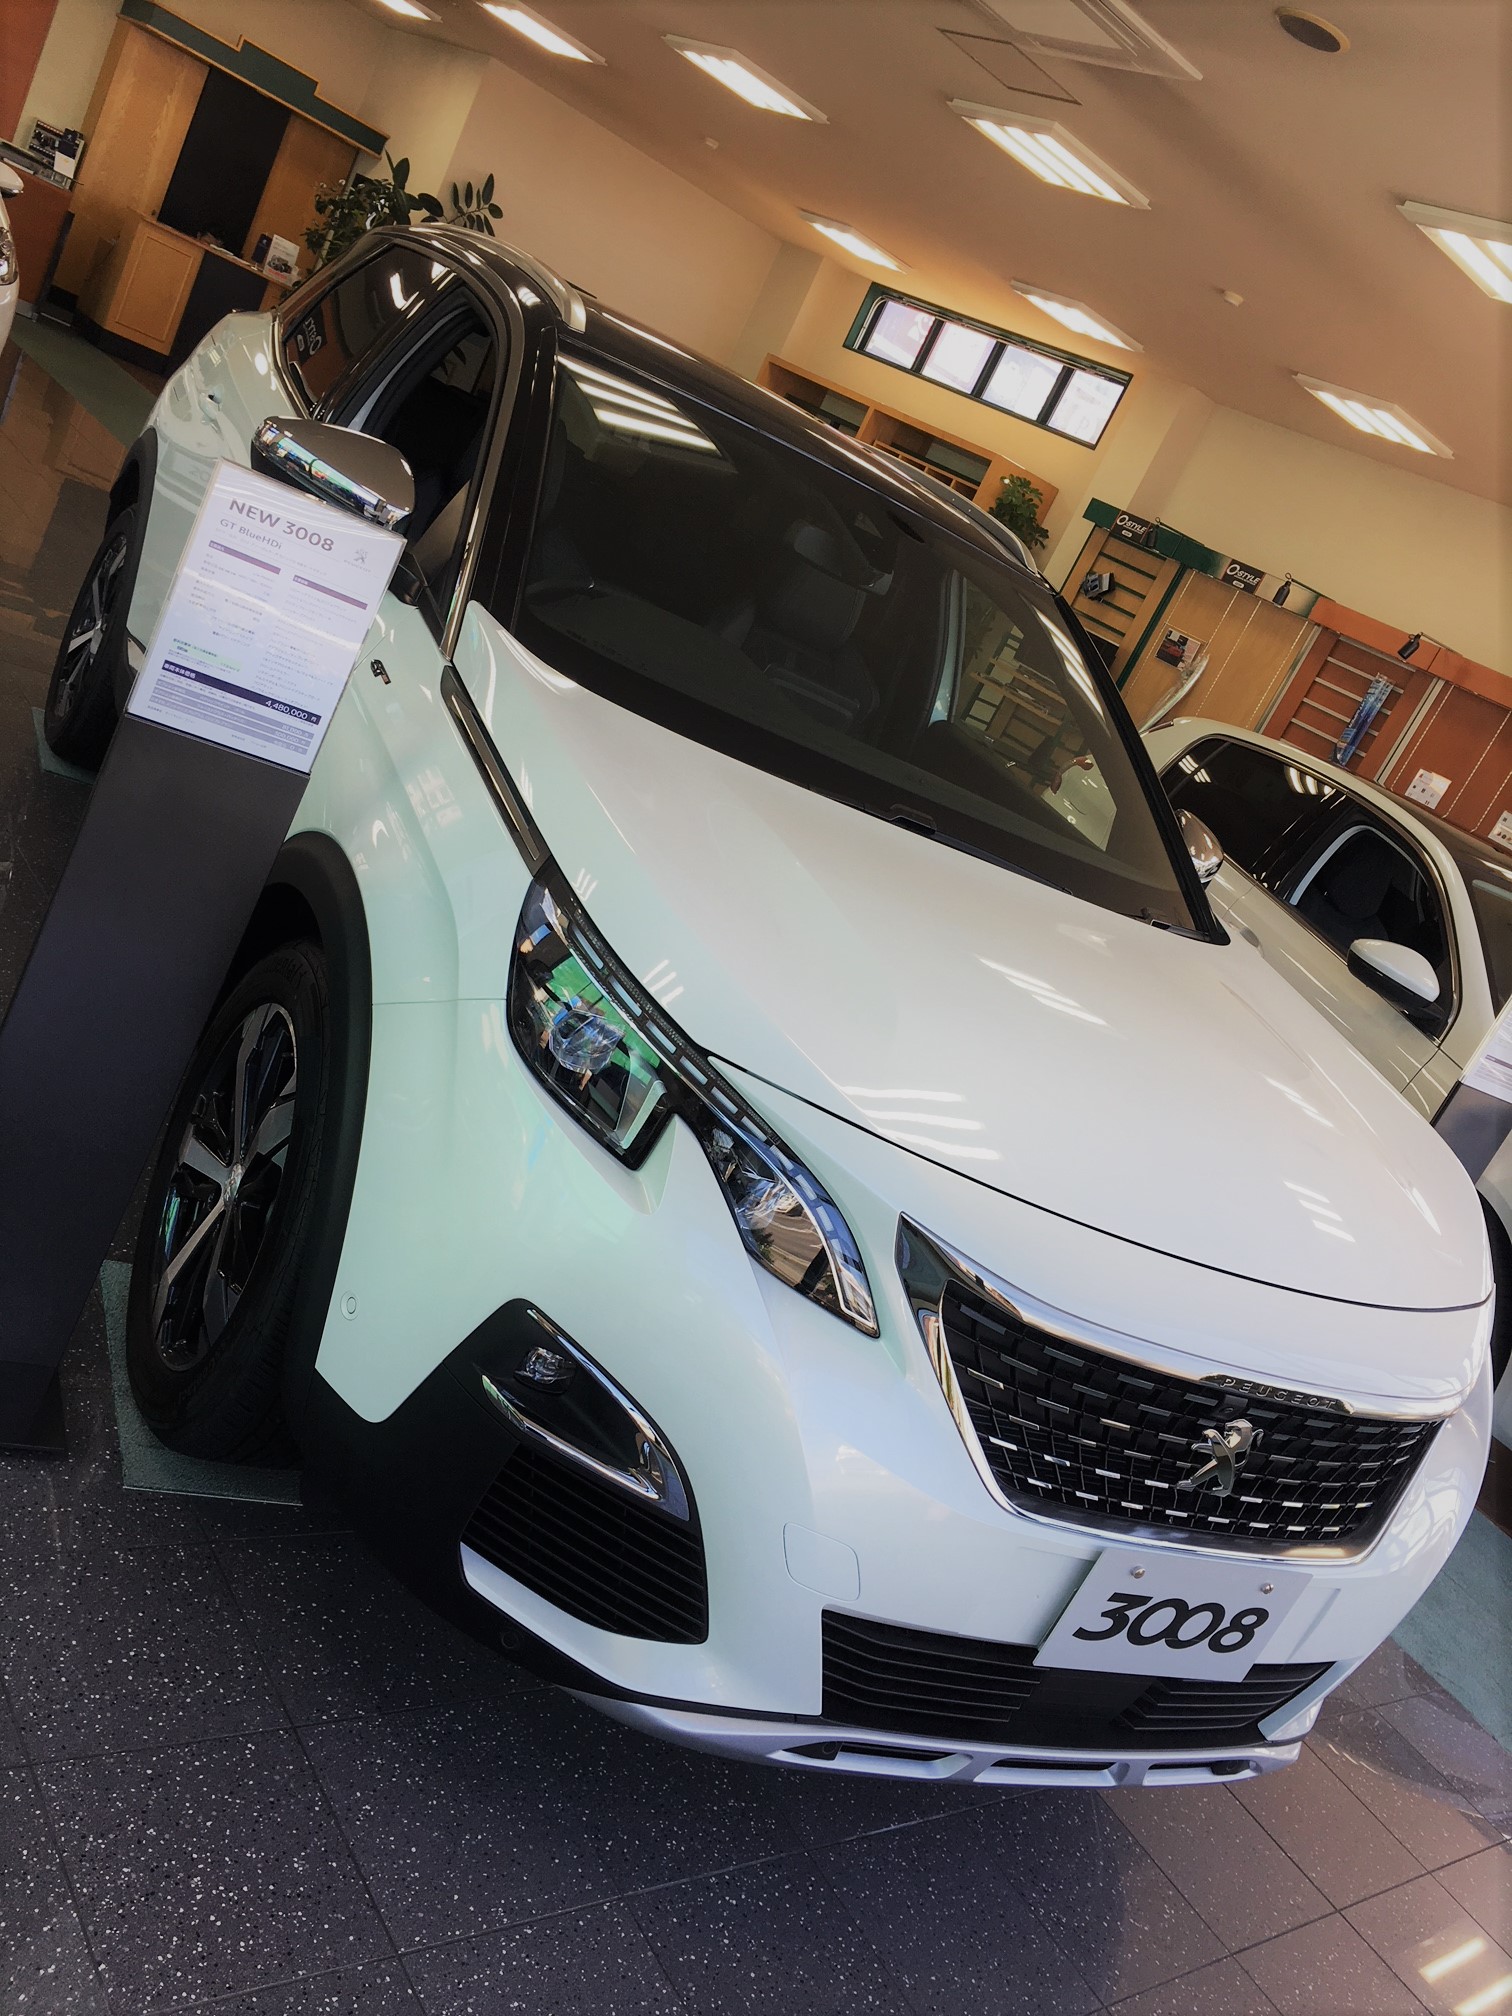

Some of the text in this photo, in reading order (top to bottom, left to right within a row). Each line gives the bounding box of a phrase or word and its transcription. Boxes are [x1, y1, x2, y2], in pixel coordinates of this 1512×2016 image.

[220, 518, 237, 530] GT
[238, 526, 282, 550] BlueHDi
[229, 499, 335, 551] NEW 3008
[265, 699, 308, 720] 4,480,000
[1220, 1377, 1338, 1409] PEUGEOT
[1072, 1591, 1270, 1654] 3008
